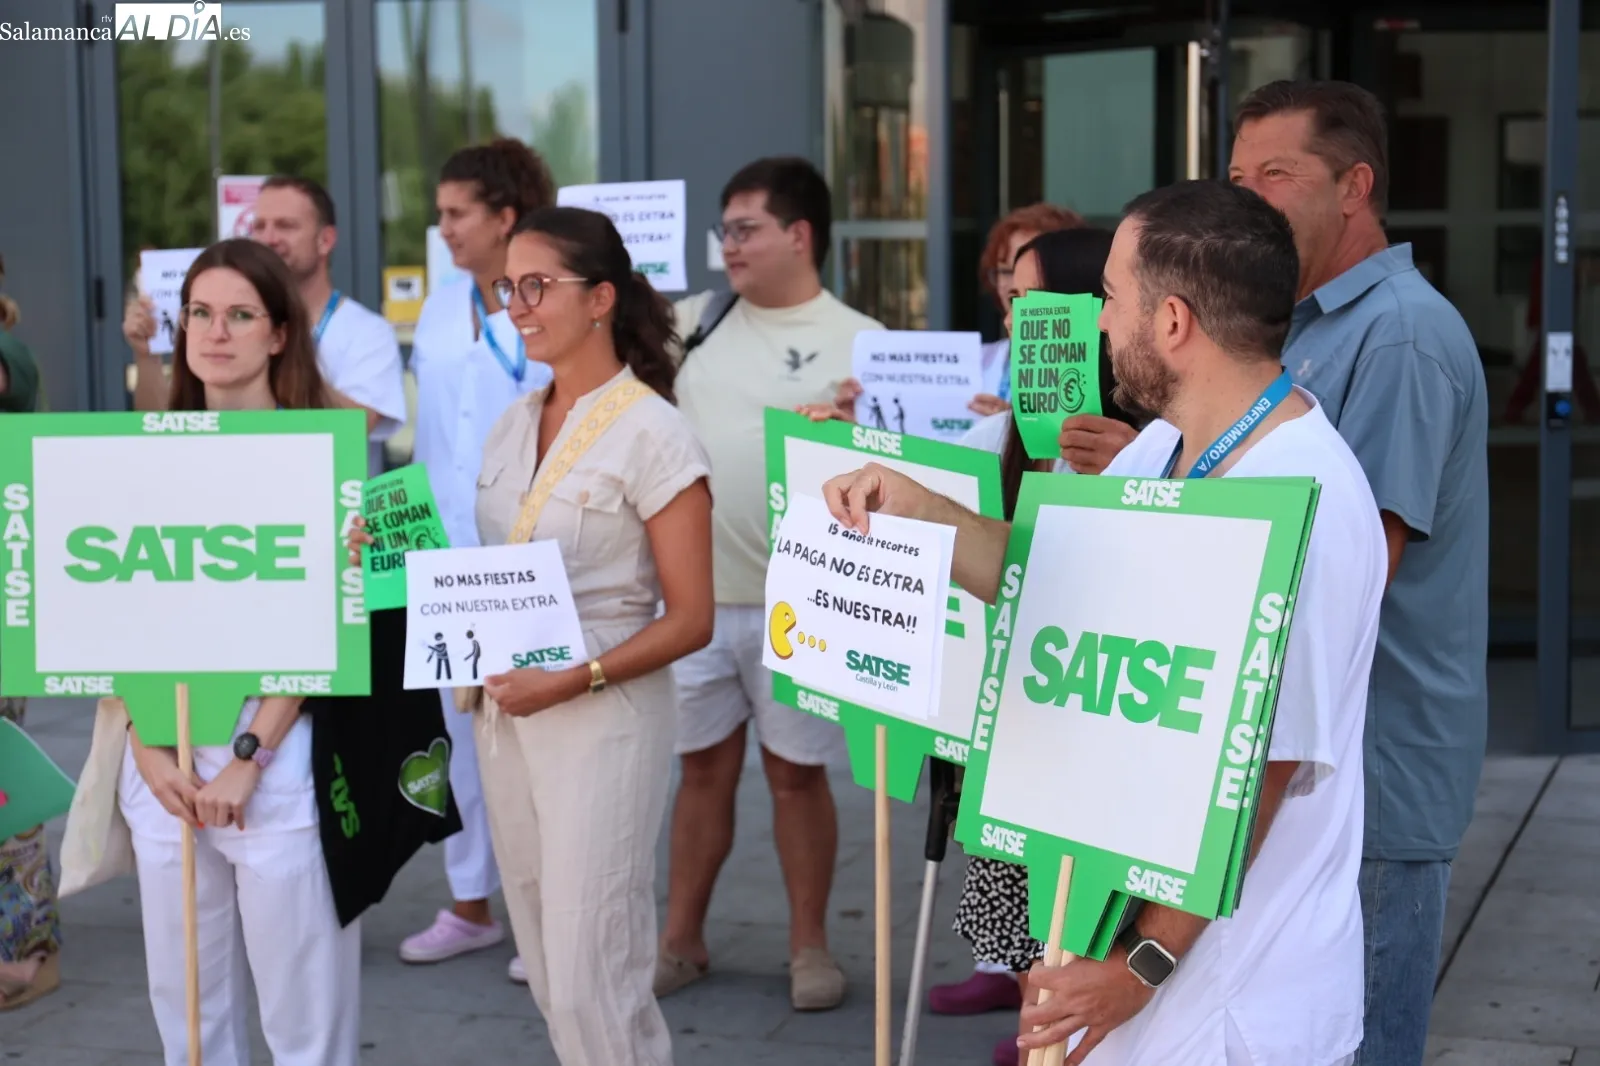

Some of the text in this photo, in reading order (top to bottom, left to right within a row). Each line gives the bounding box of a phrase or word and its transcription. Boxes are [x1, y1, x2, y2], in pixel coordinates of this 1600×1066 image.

[1029, 307, 1053, 317] NUESTRA
[1020, 318, 1071, 341] QUE NO
[1018, 342, 1087, 364] SE COMAN
[1018, 367, 1059, 389] NI UN
[1018, 391, 1059, 414] EURO
[142, 412, 219, 432] SATSE
[1197, 397, 1272, 472] ENFERMERO/A
[851, 426, 903, 456] SATSE
[388, 488, 408, 508] NO
[1120, 479, 1185, 508] SATSE
[384, 502, 432, 529] COMAN
[387, 530, 409, 549] UN
[828, 522, 839, 535] 15
[875, 538, 920, 557] recortes
[2, 483, 31, 626] SATSE
[63, 524, 306, 583] SATSE
[370, 552, 405, 572] EUR
[777, 537, 924, 595] LA PAGA NO ES EXTRA
[434, 570, 536, 589] NO MAS FIESTAS
[420, 594, 558, 616] CON NUESTRA EXTRA
[512, 646, 573, 669] SATSE
[845, 649, 911, 686] SATSE
[972, 563, 1022, 751] SATSE
[45, 675, 114, 694] SATSE
[260, 674, 331, 693] SATSE
[855, 673, 877, 687] Castilla
[882, 681, 898, 692] León
[1022, 625, 1217, 735] SATSE
[796, 689, 840, 721] SATSE
[1216, 592, 1286, 810] SATSE
[979, 822, 1027, 858] SATSE
[1125, 865, 1187, 906] SATSE
